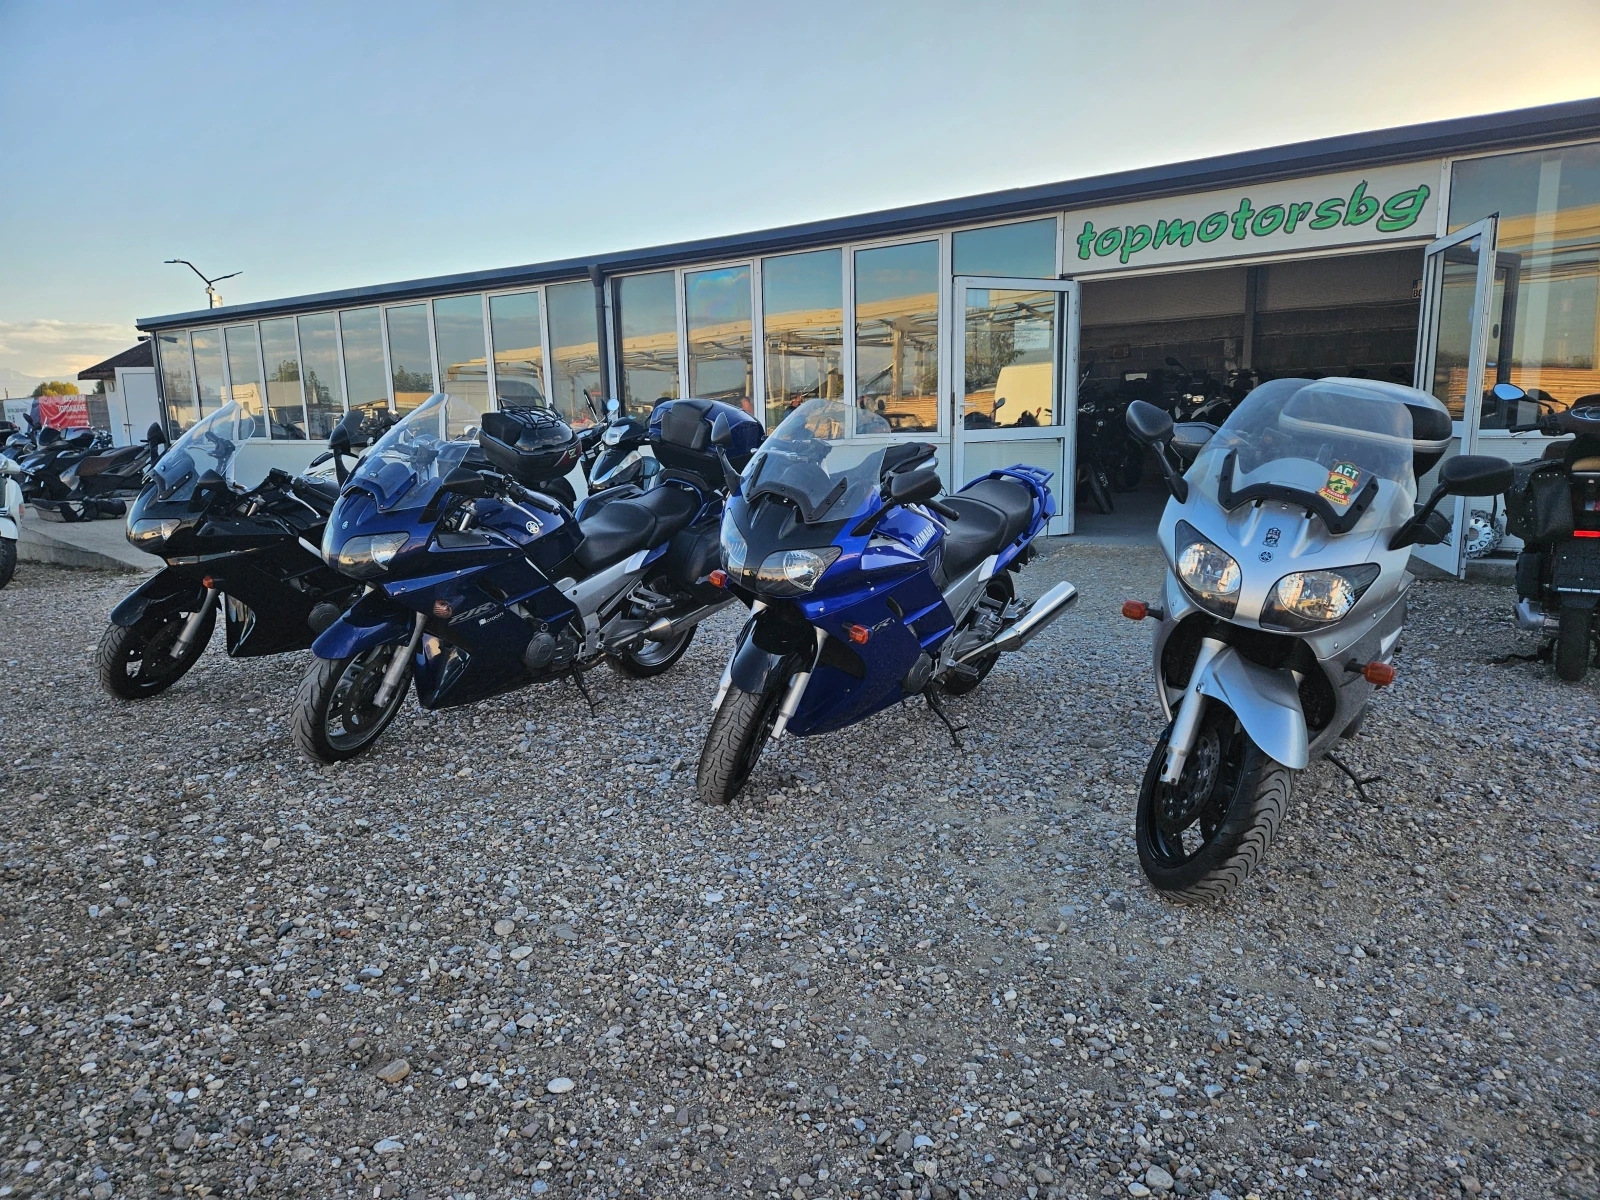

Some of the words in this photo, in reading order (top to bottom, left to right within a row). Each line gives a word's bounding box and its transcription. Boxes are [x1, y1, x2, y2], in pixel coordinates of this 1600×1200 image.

[1077, 180, 1431, 264] topmotorsbg
[1334, 464, 1359, 480] ACT
[911, 522, 938, 549] YAMAHA
